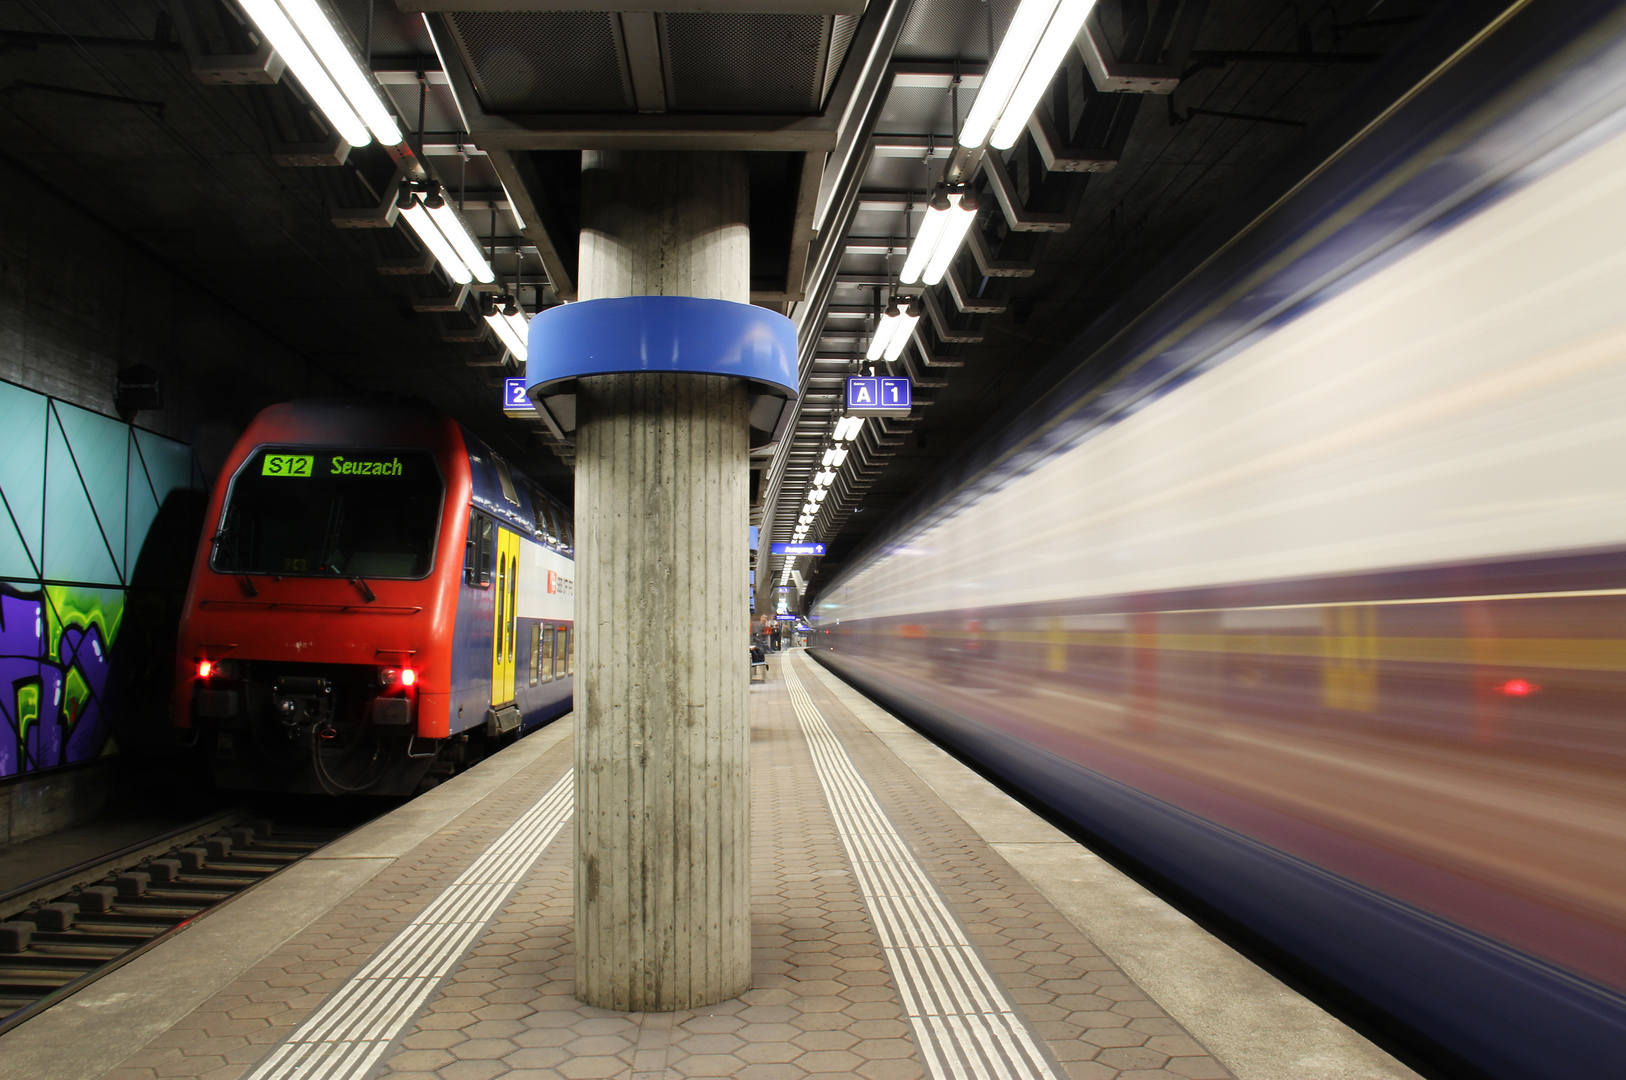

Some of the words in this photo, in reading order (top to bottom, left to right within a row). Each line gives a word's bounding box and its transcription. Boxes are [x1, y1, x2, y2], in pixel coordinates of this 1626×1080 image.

[513, 386, 526, 403] 2
[856, 386, 871, 403] A
[890, 386, 898, 403] 1
[268, 457, 308, 474] S12
[330, 456, 403, 476] Seuzach
